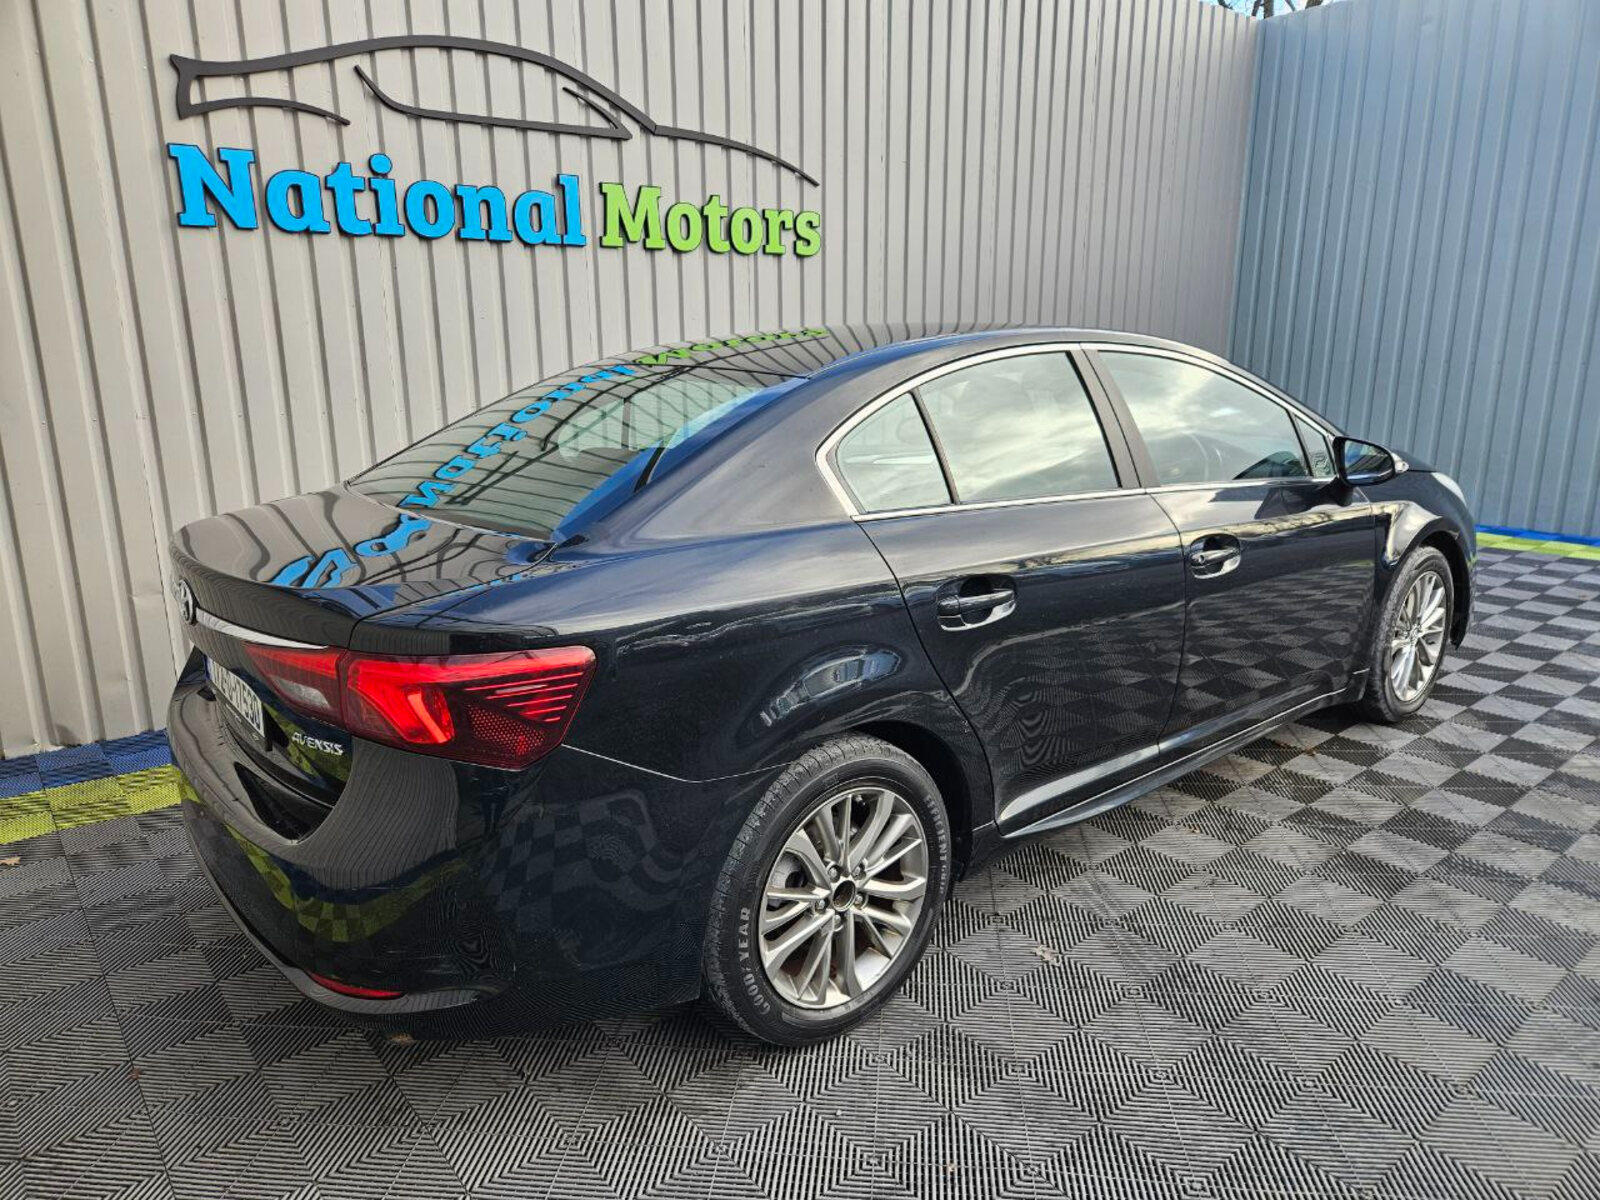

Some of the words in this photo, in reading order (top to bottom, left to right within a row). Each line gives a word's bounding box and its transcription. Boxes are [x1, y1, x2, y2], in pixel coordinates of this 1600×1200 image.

[167, 142, 587, 247] National
[599, 182, 821, 257] Motors
[291, 731, 344, 756] AVENSIS
